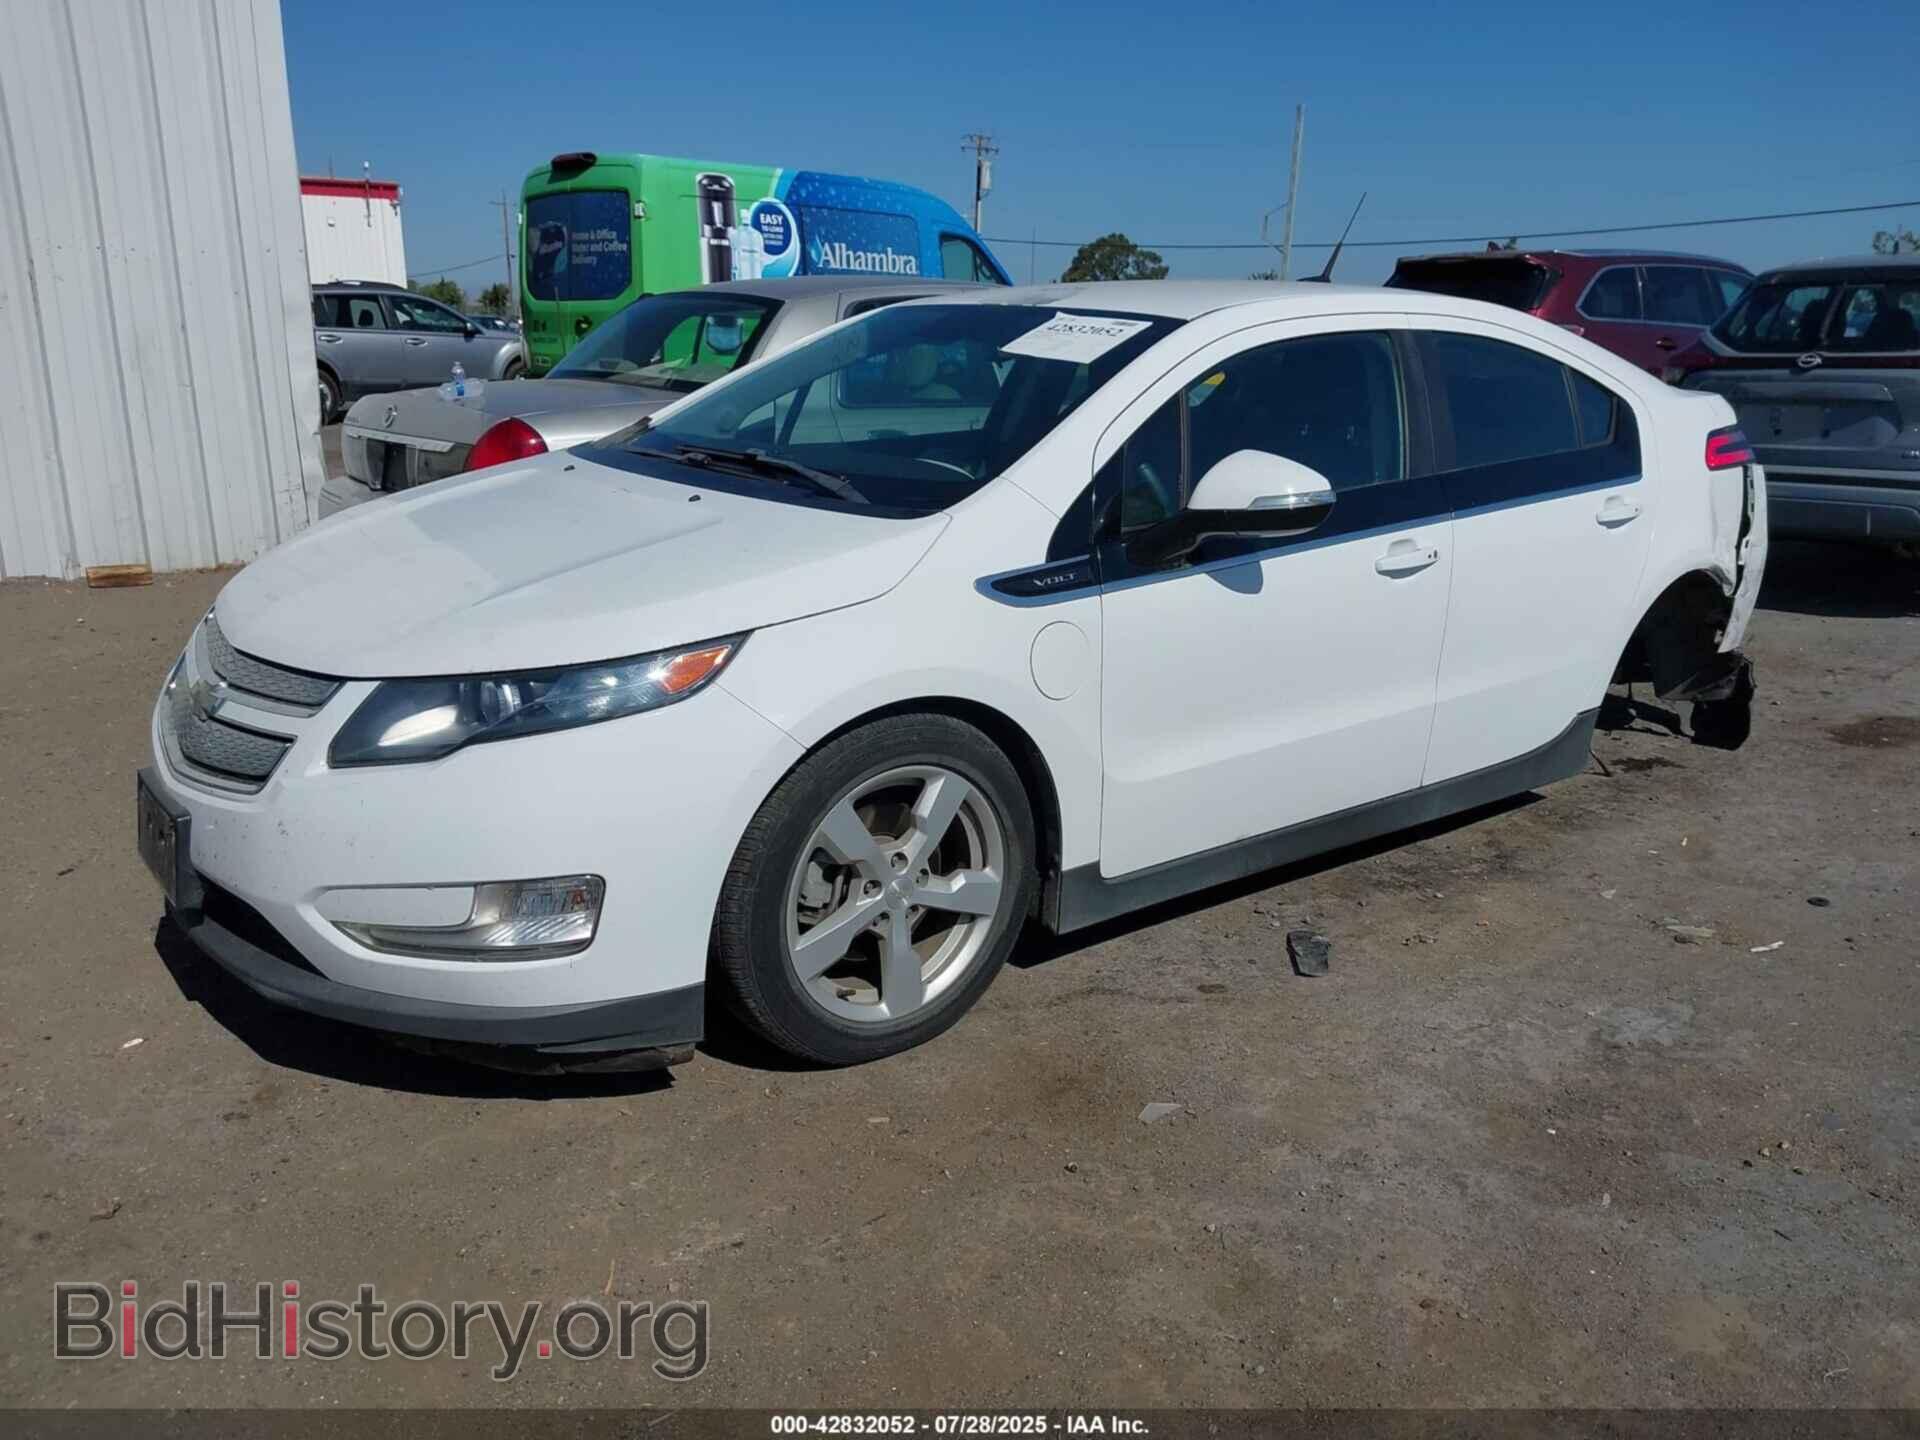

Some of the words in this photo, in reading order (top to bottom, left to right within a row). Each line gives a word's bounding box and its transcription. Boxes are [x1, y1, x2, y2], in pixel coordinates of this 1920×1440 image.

[760, 212, 784, 225] EASY
[817, 242, 919, 275] Alhambra
[1033, 574, 1076, 586] VOLT
